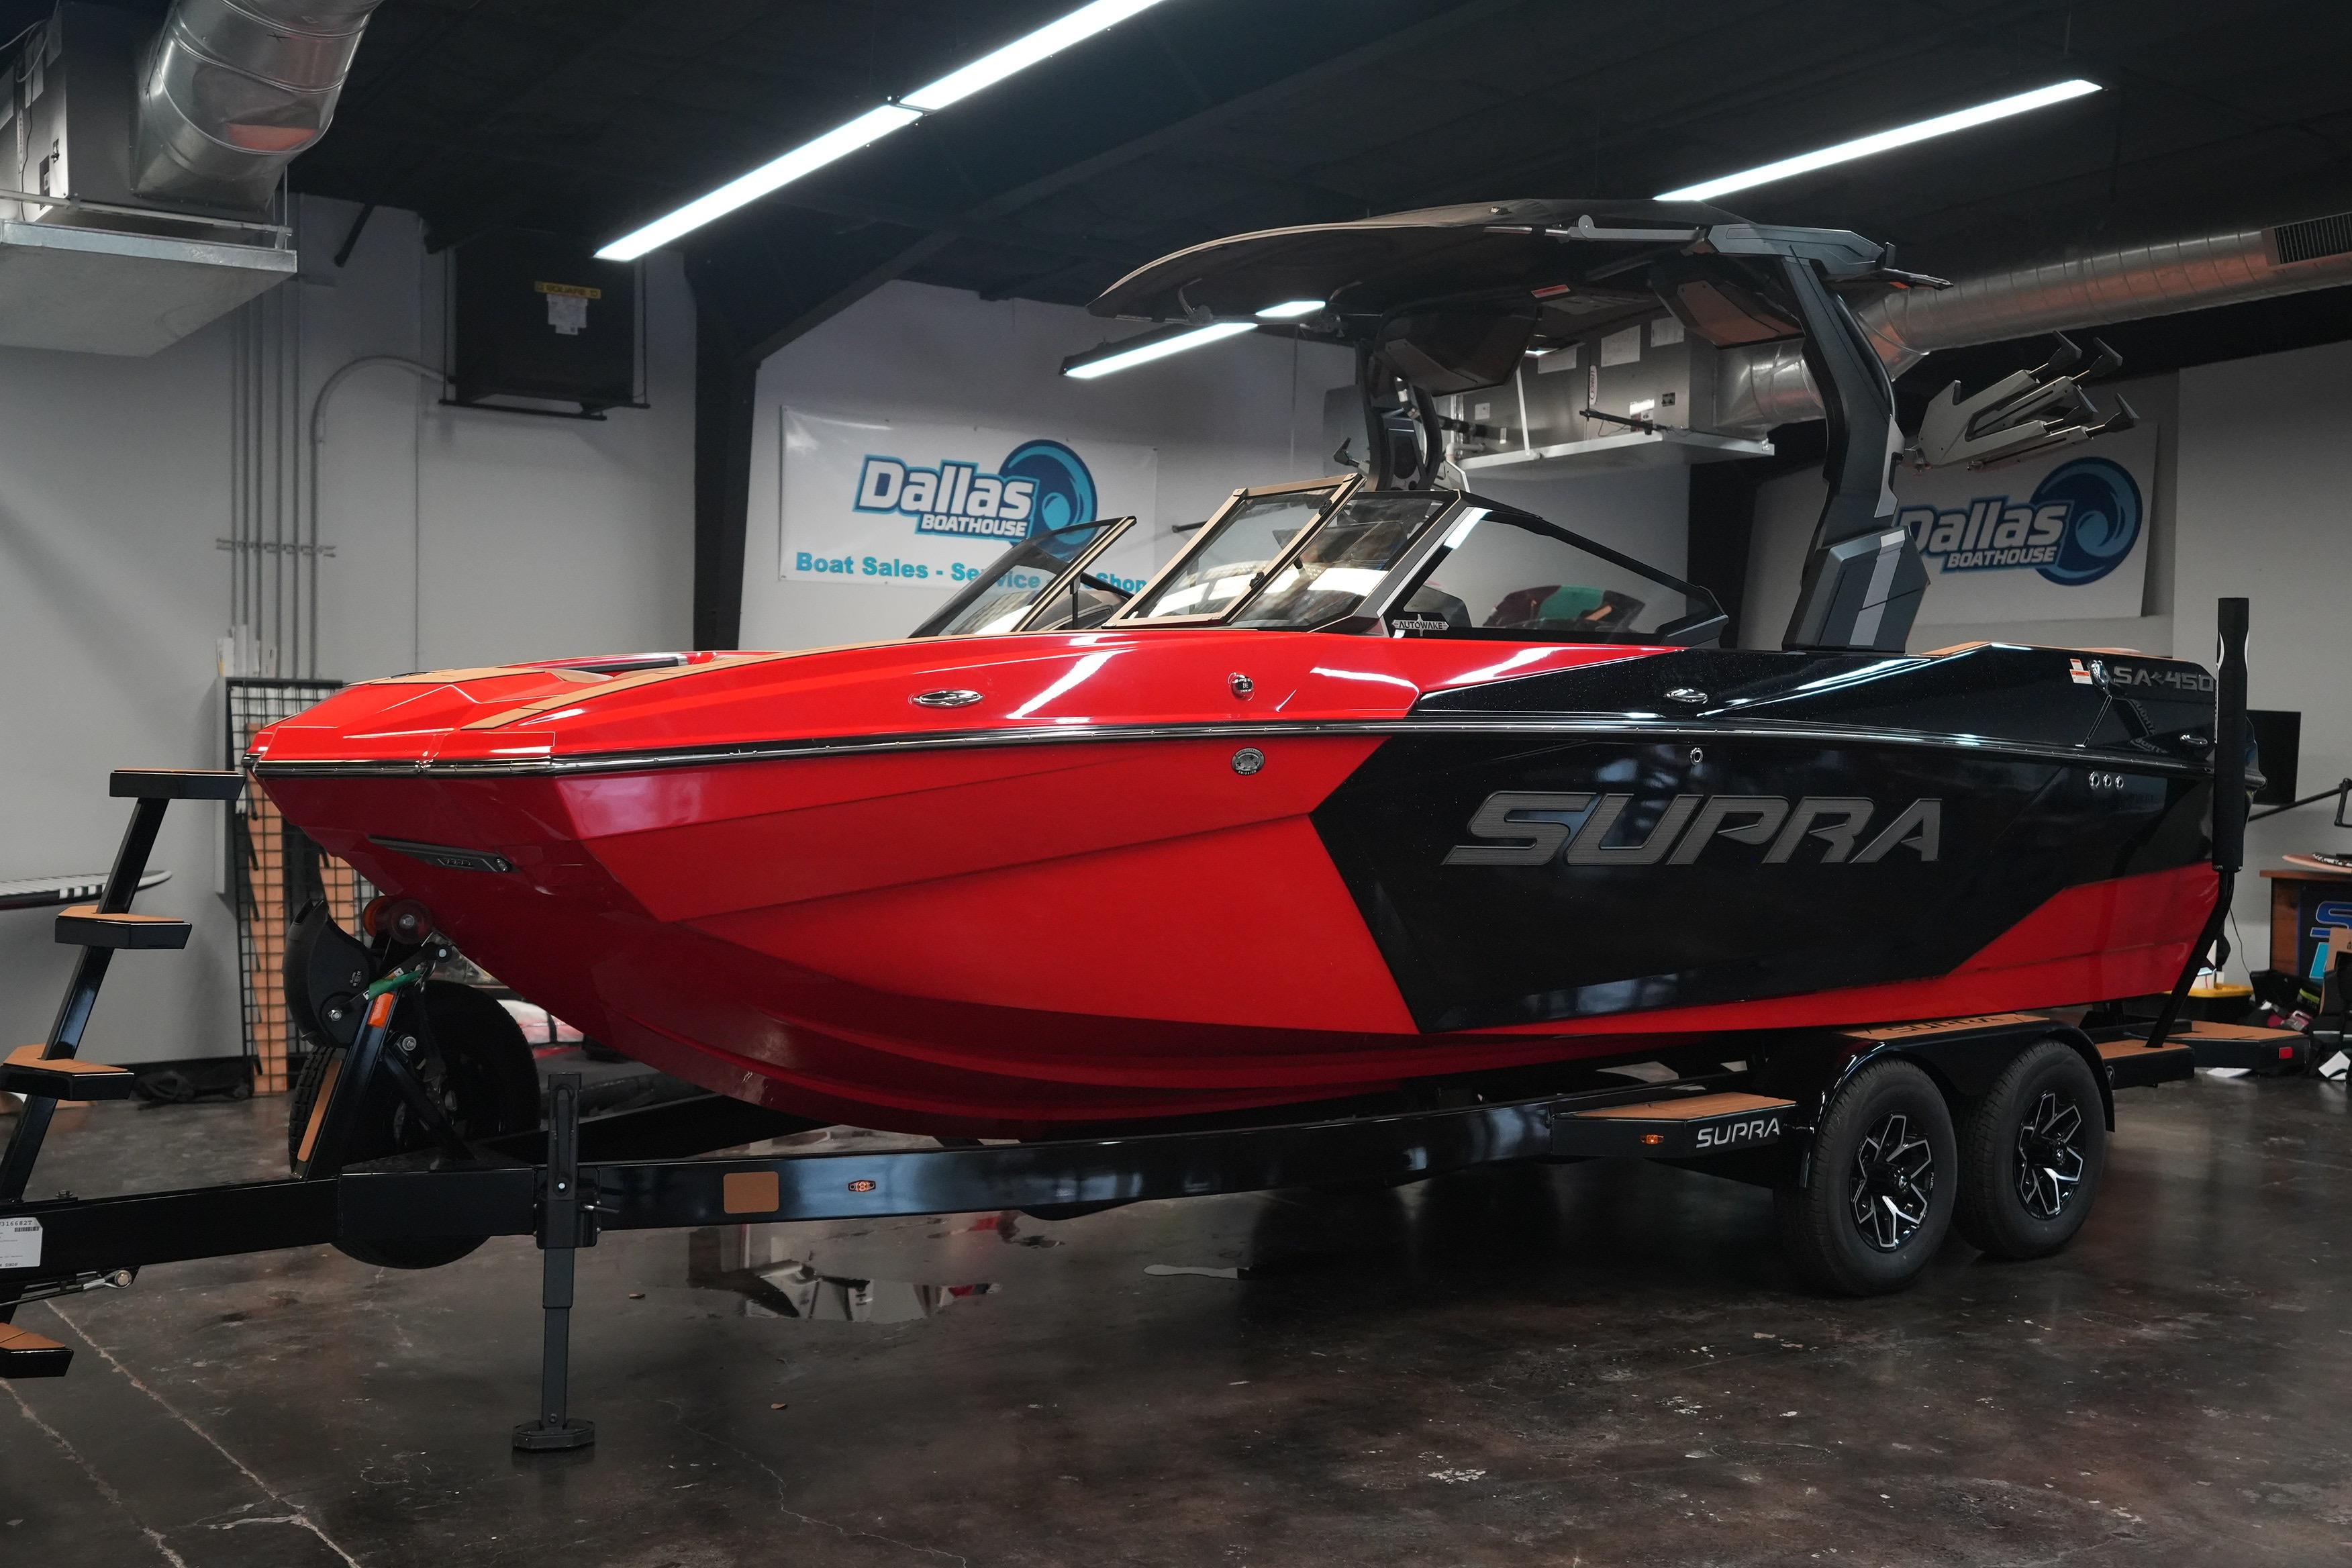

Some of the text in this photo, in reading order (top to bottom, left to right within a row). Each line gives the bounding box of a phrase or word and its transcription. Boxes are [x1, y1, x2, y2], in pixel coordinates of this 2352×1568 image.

[859, 460, 1034, 520] Dallas
[921, 514, 1028, 537] BOATHOUSE
[1899, 501, 2068, 553] Dallas
[796, 552, 854, 574] Boat
[862, 556, 928, 579] Sales
[951, 562, 1040, 589] Sevice
[1947, 546, 2057, 568] BOATHOUSE
[1399, 621, 1443, 630] AUTOWAKE
[1440, 791, 1943, 866] SUPRA
[1696, 1118, 1780, 1148] SUPRA
